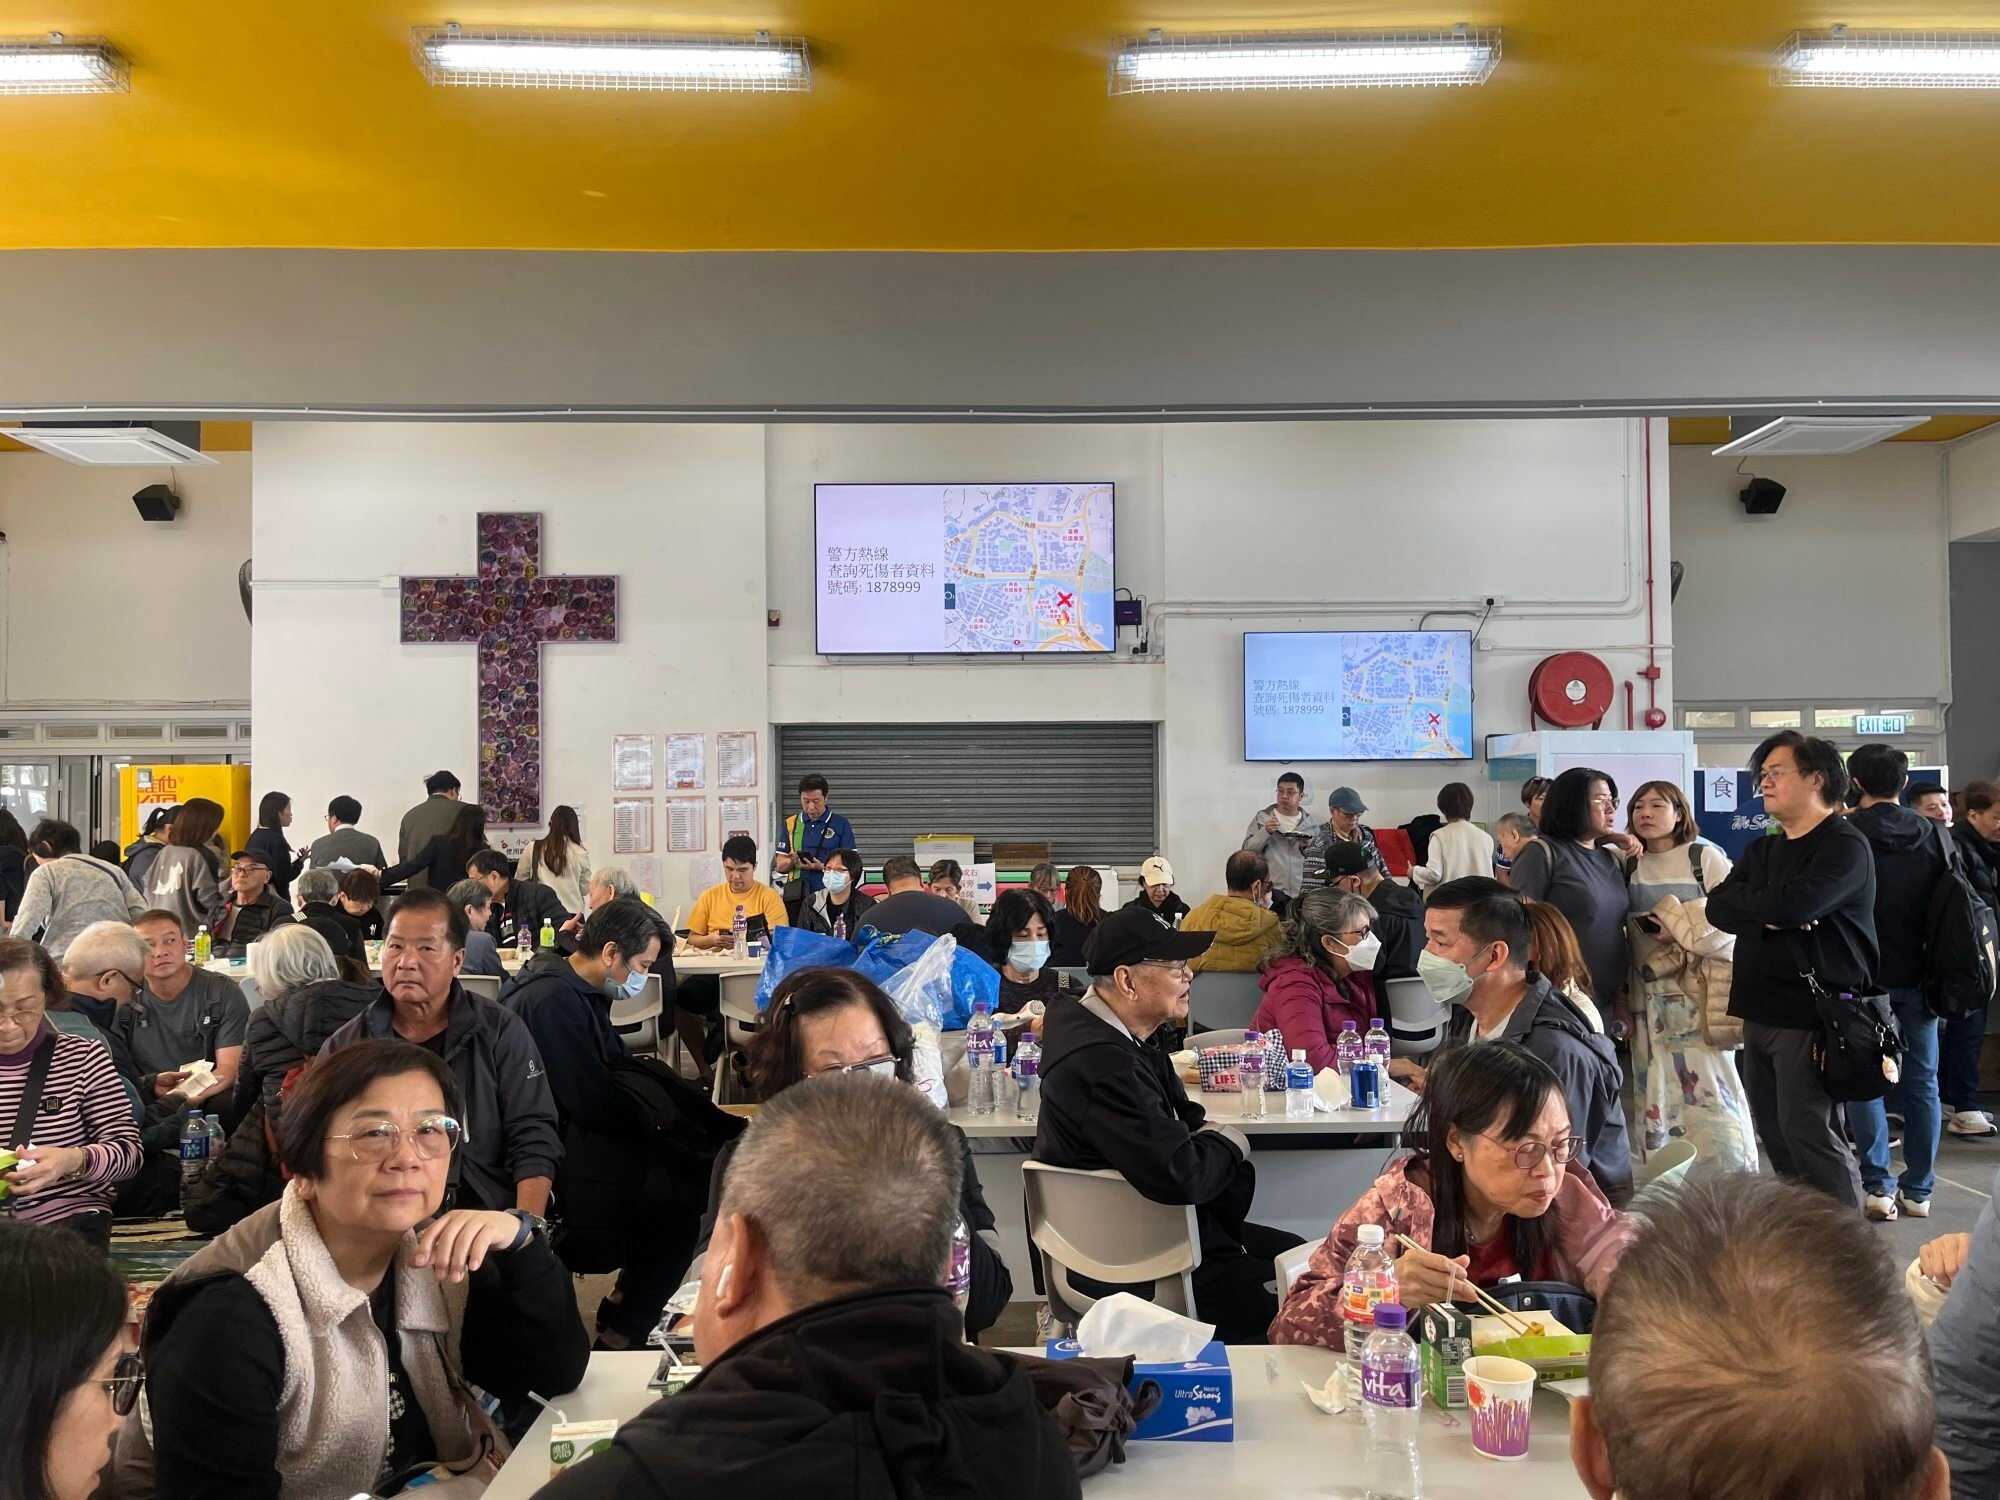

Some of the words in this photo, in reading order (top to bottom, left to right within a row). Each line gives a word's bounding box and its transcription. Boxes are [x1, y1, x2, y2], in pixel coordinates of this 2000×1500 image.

[828, 546, 889, 562] 警方熱線
[829, 562, 935, 578] 查詢死傷者資料
[828, 580, 862, 595] 號碼:
[867, 581, 921, 593] 1878999
[1283, 705, 1324, 714] 1878999
[1860, 718, 1880, 732] EXIT
[1883, 718, 1901, 732] 出口
[1710, 776, 1734, 798] 食
[1364, 1371, 1406, 1398] vita
[1174, 1389, 1193, 1399] Ultra
[1192, 1384, 1221, 1404] Strong
